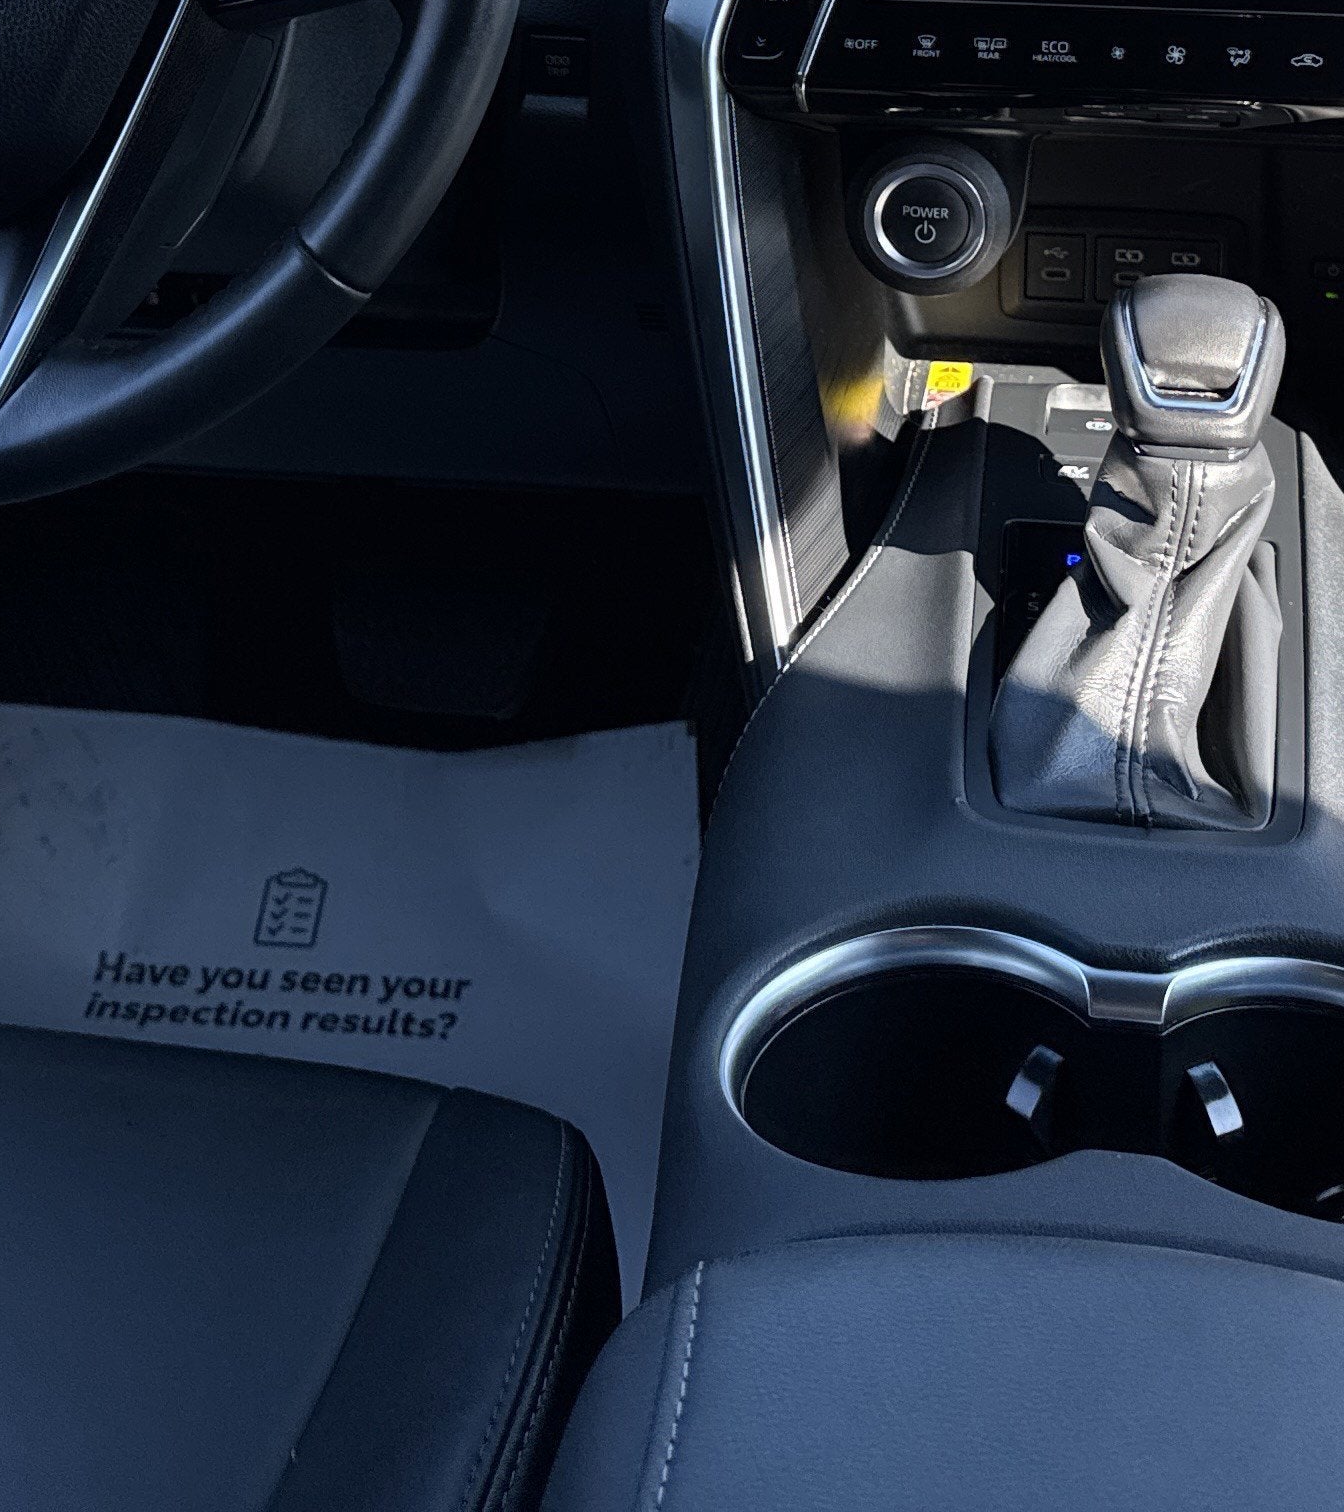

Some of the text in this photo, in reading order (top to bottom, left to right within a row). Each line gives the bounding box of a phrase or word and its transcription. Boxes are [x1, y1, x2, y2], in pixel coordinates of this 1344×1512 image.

[855, 38, 879, 50] OFF
[1041, 40, 1070, 54] ECO
[912, 48, 941, 59] FRONT
[977, 50, 1001, 61] REAR
[902, 204, 949, 220] POWER
[93, 949, 473, 1005] Have you seen your
[83, 991, 460, 1041] inspection results?
